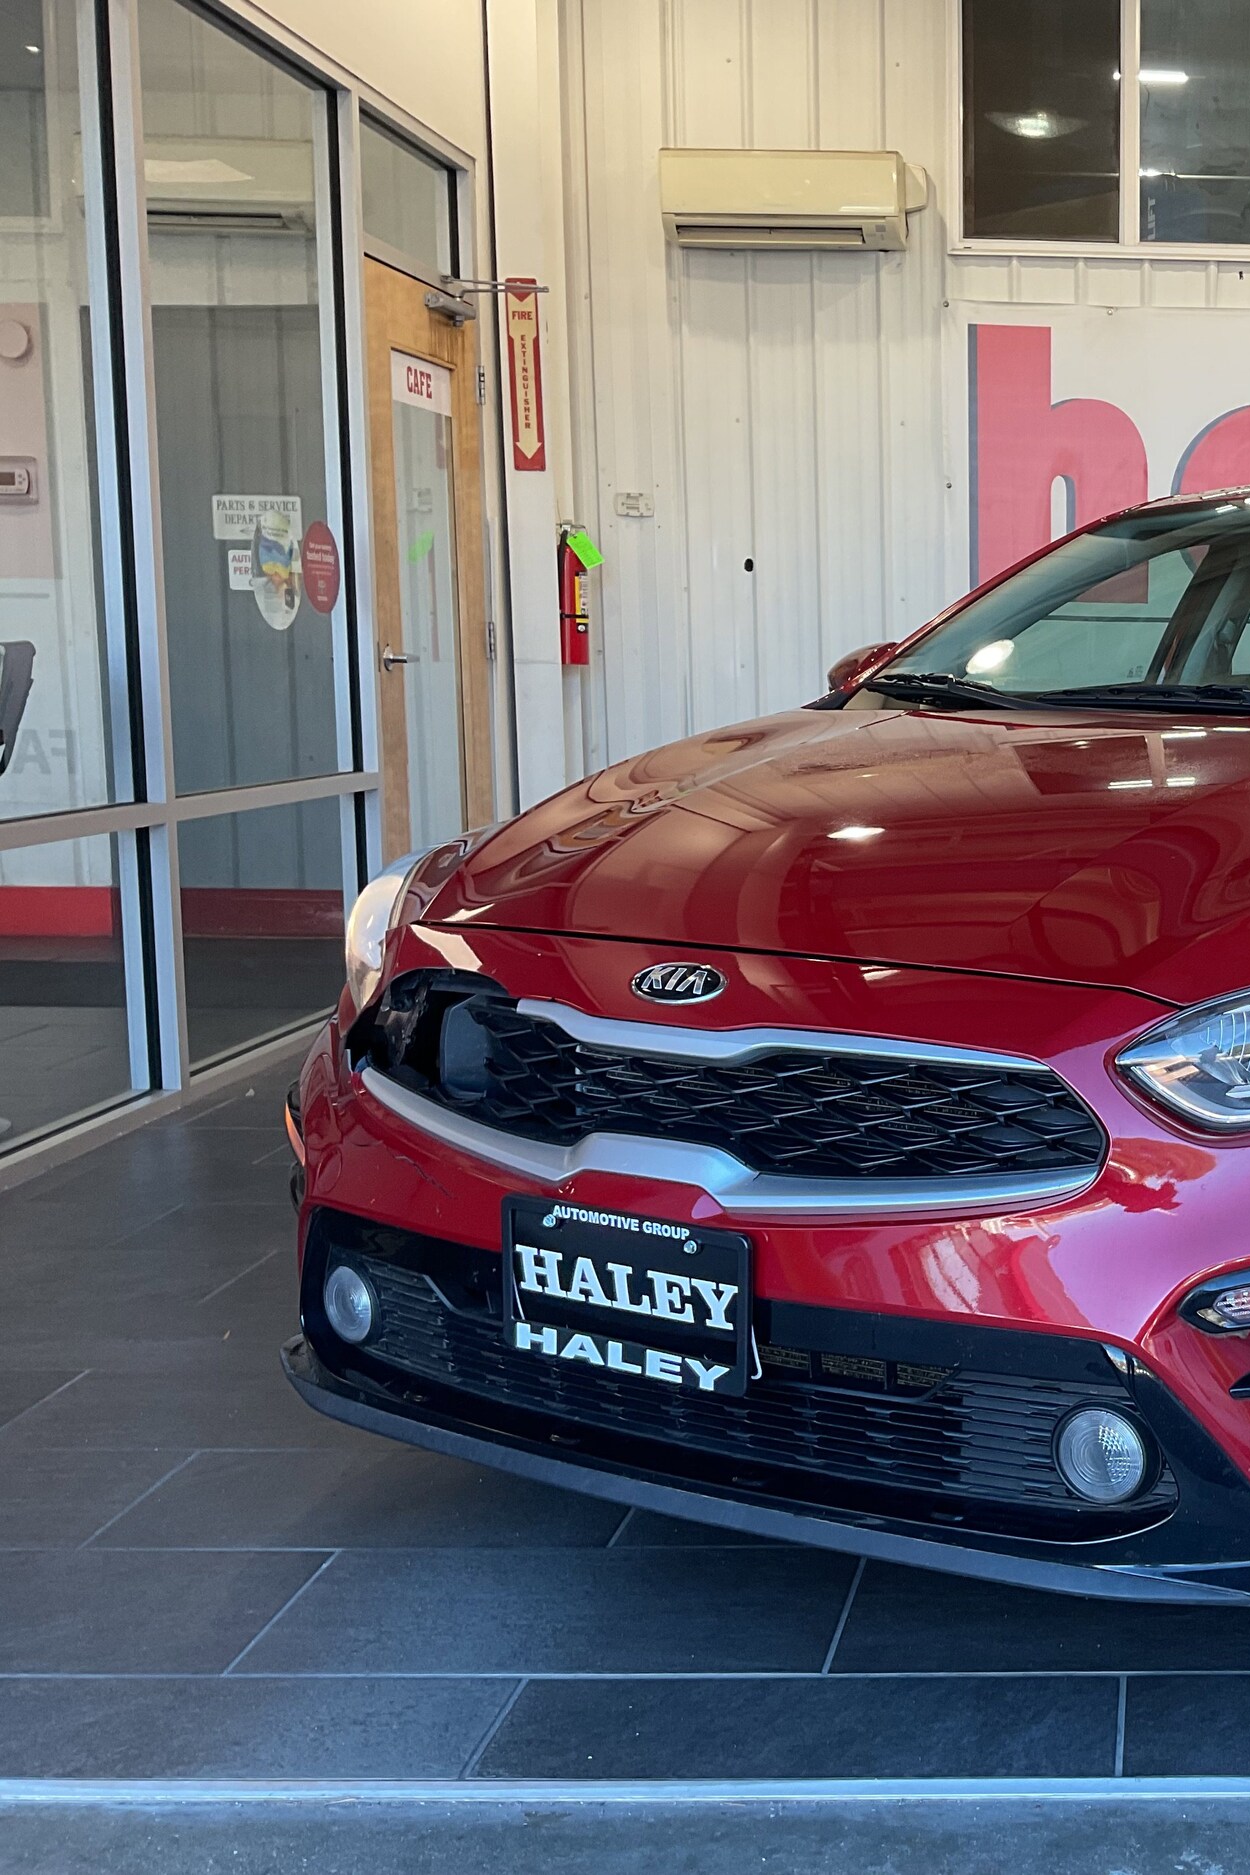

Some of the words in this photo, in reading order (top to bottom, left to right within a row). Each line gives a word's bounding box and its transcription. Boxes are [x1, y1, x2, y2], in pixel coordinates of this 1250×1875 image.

[511, 310, 534, 321] FIRE
[406, 365, 433, 399] CAFE
[519, 334, 532, 430] EXTINGUISHER
[216, 500, 246, 511] PARTS
[258, 501, 298, 512] SERVICE
[641, 967, 708, 995] KIA
[552, 1205, 640, 1232] AUTOMOTIVE
[642, 1221, 690, 1240] GROUP
[515, 1244, 739, 1331] HALEY
[516, 1322, 730, 1391] HALEY
